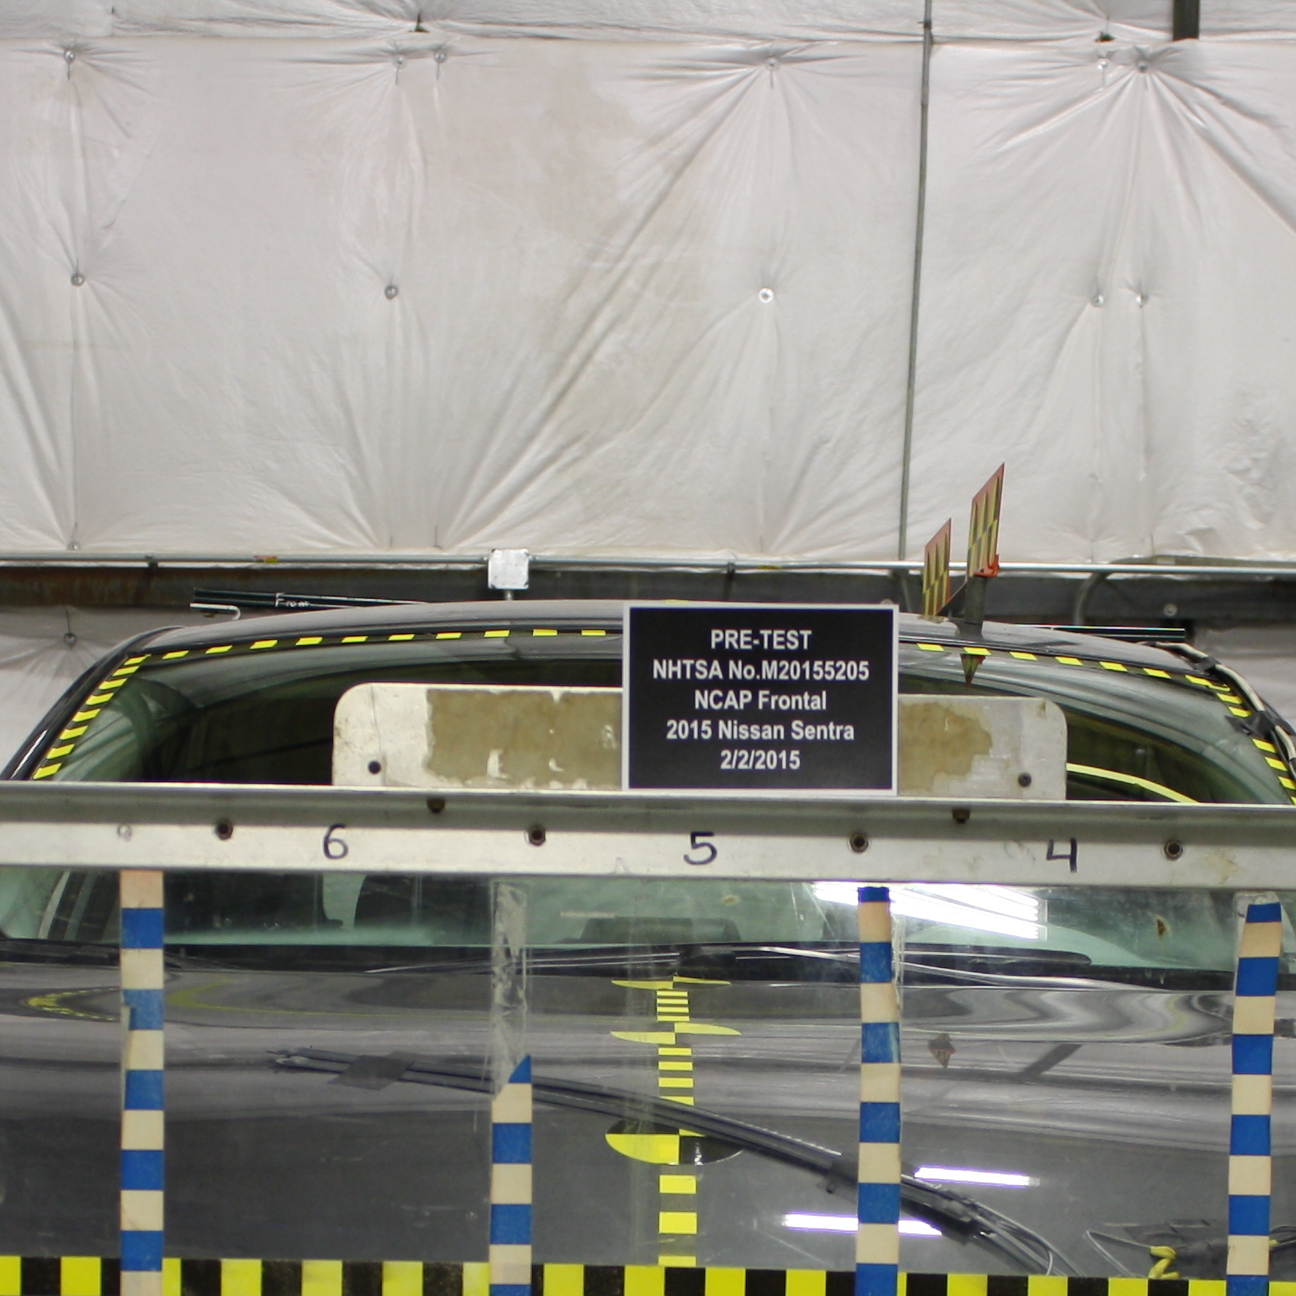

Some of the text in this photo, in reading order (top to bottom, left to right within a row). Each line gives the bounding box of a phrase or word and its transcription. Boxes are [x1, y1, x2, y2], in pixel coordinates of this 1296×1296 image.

[710, 629, 812, 650] PRE-TEST
[653, 659, 870, 681] NHTSA No.M20155205
[694, 690, 827, 710] NCAP Frontal
[666, 720, 855, 740] 2015 Nissan Sentra
[720, 750, 801, 770] 2/2/2015
[323, 824, 350, 859] 6
[684, 832, 718, 865] 5
[1045, 839, 1077, 873] 4
